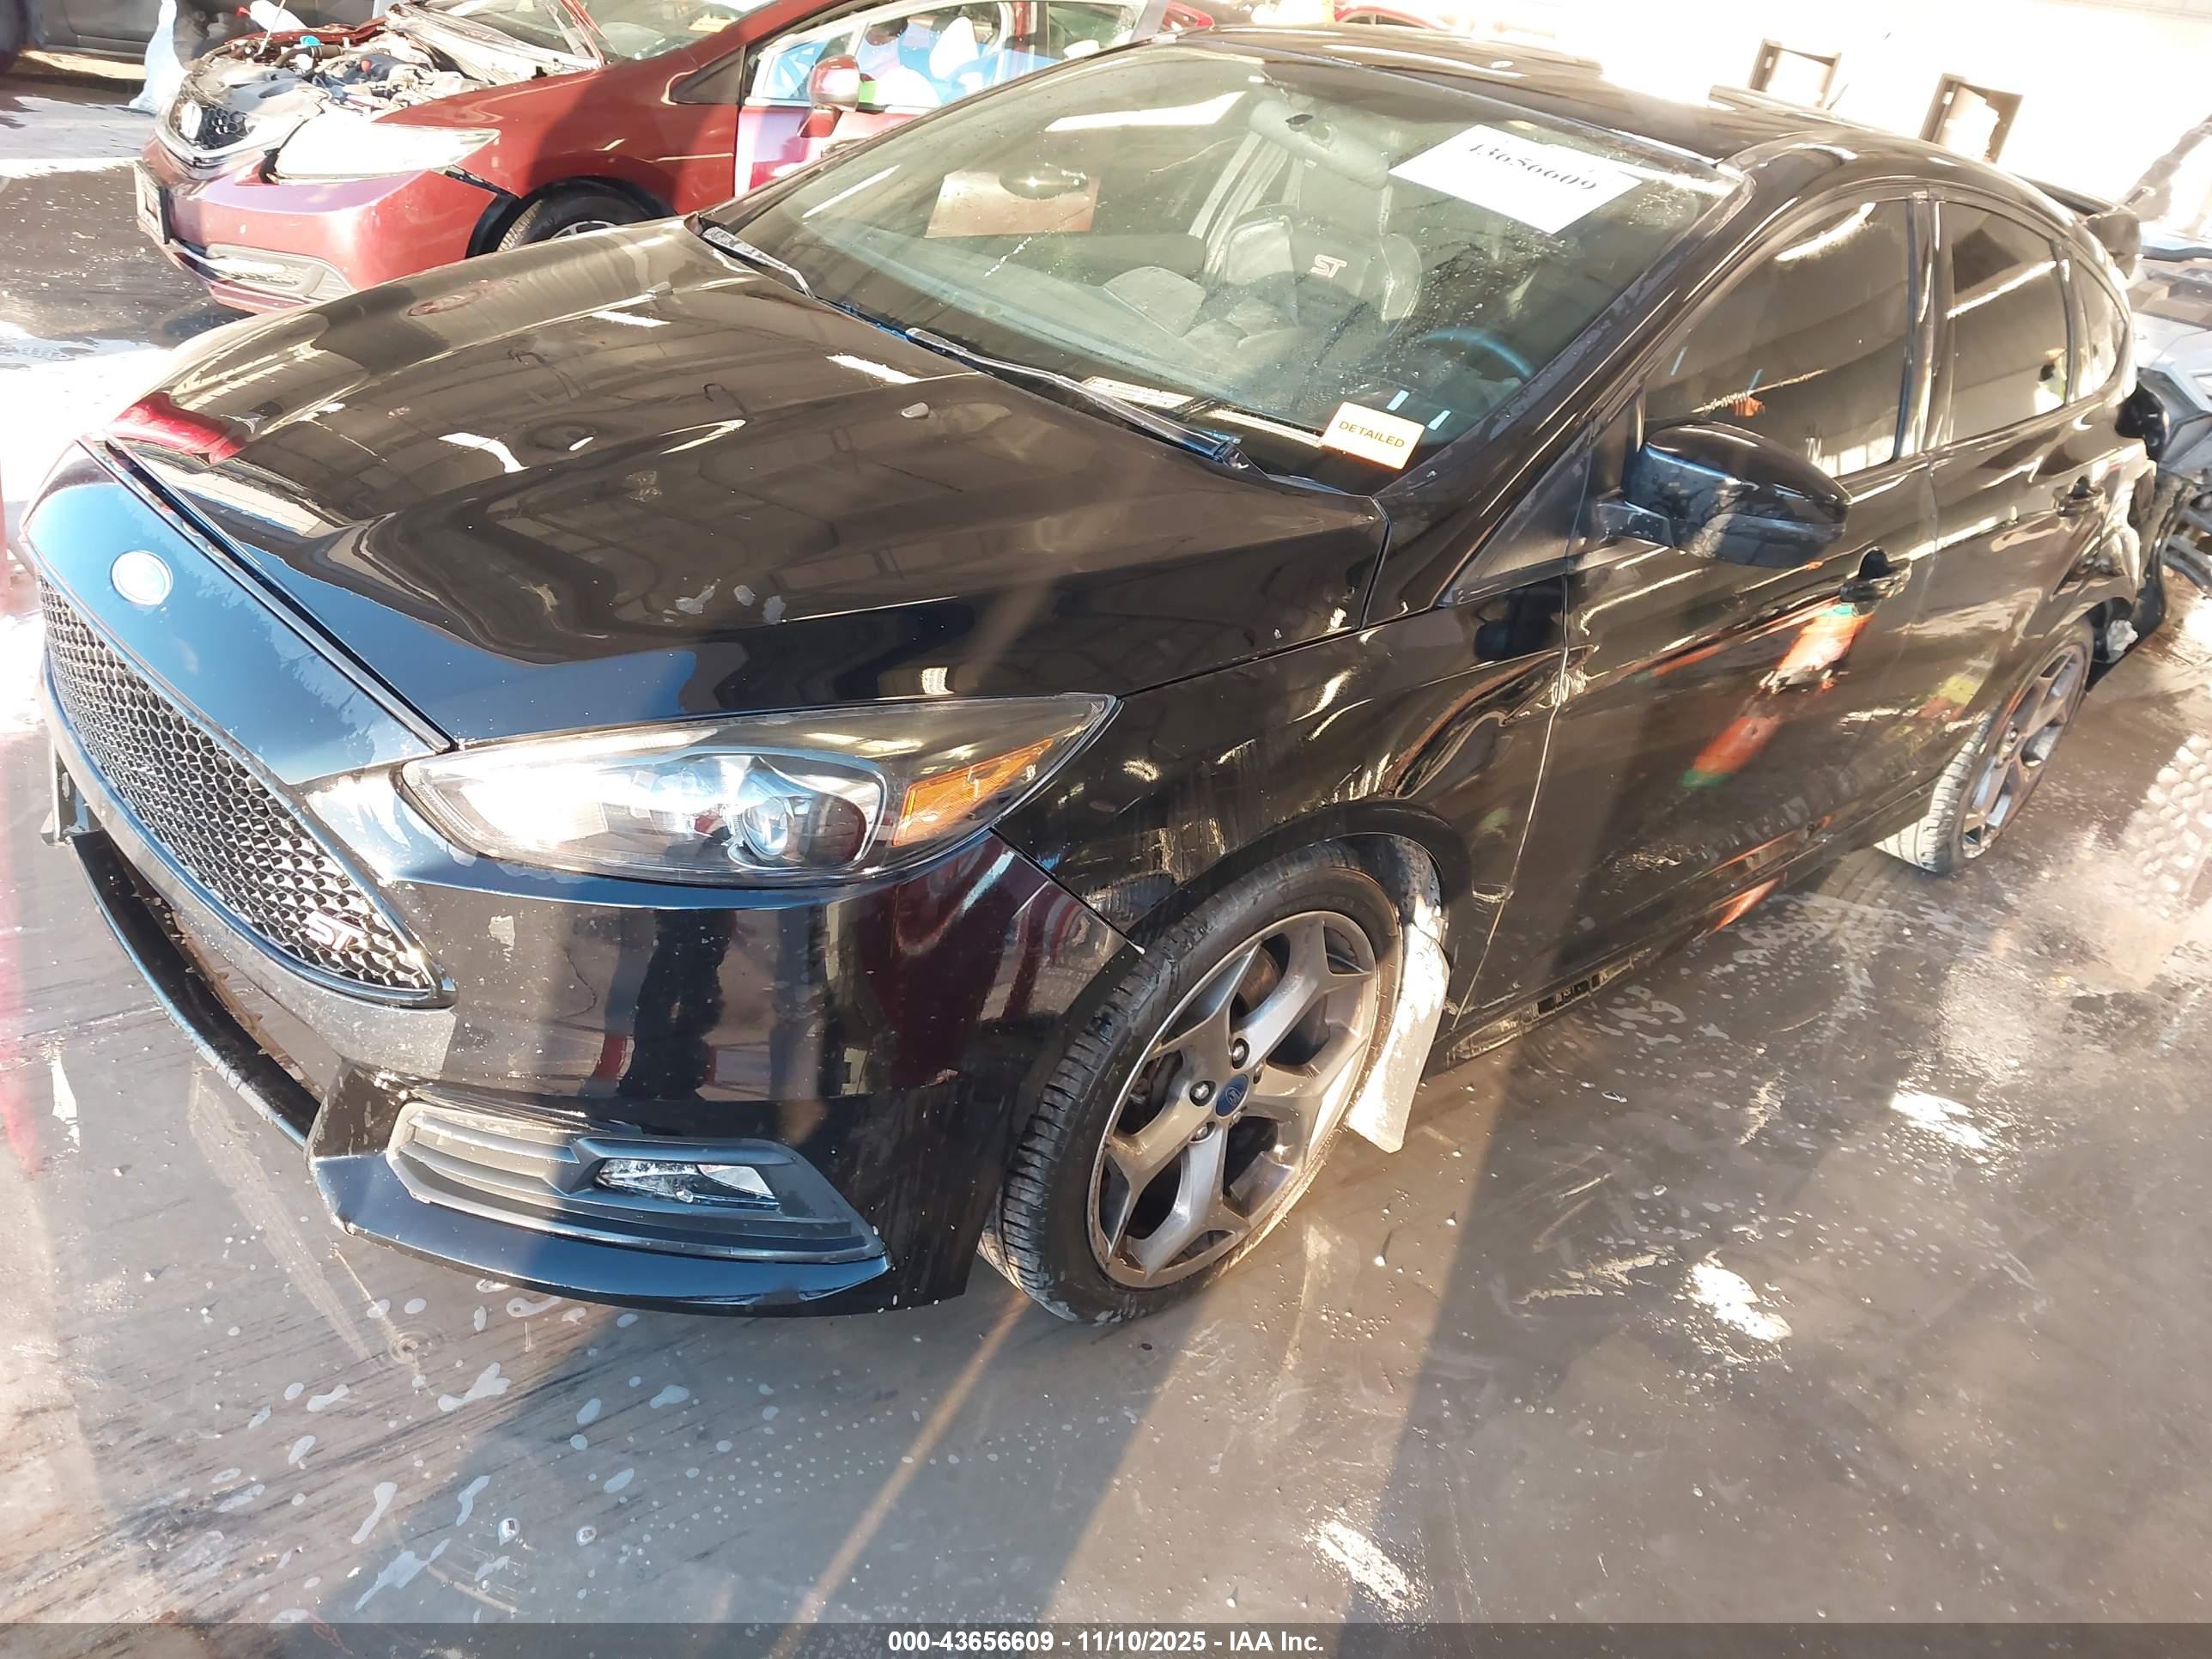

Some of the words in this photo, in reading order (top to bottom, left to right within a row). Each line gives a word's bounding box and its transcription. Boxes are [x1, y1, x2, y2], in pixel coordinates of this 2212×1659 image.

[1310, 253, 1347, 278] ST
[1339, 420, 1406, 448] DETAILED
[303, 910, 367, 951] ST
